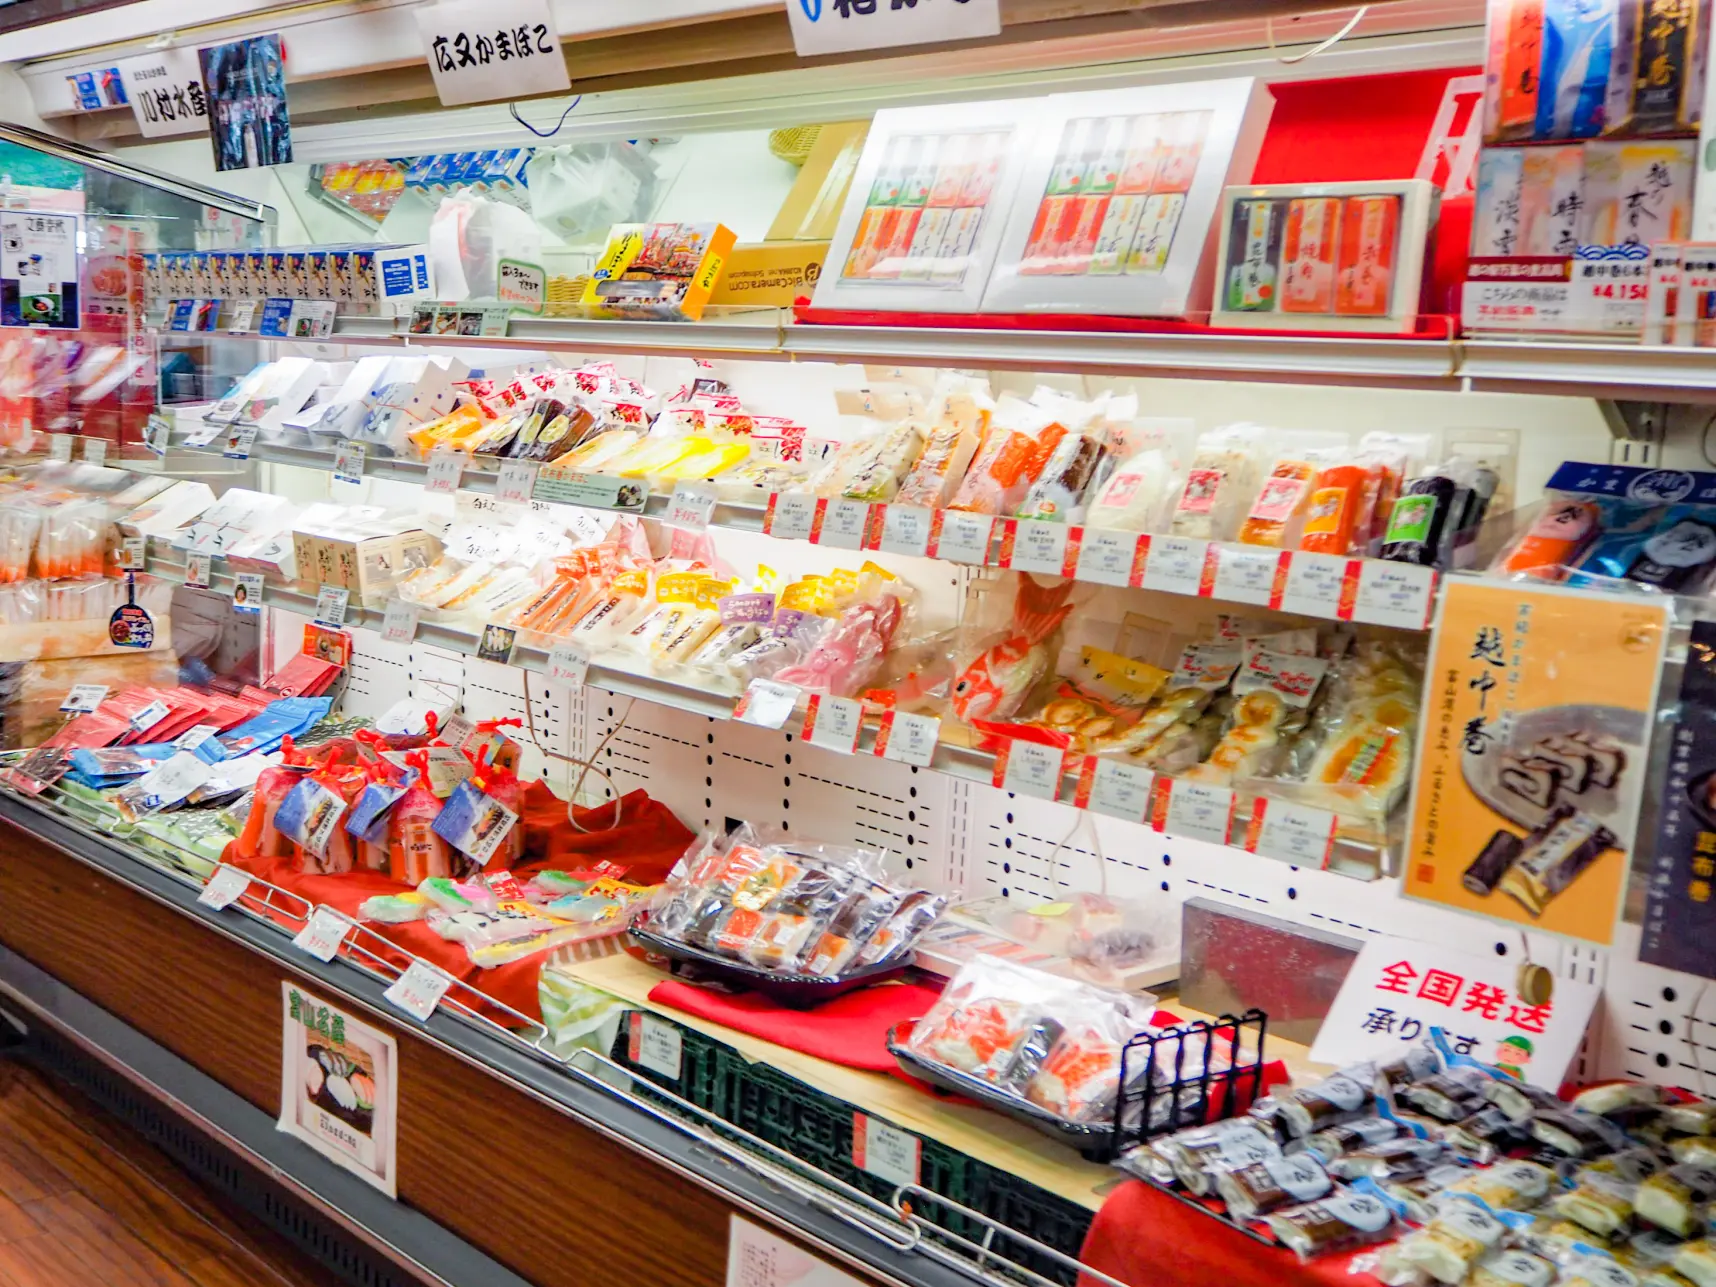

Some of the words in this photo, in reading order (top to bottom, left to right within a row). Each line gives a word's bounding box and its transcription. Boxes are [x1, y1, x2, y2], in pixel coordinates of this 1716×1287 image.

[432, 23, 554, 73] 広又かまぼこ
[1462, 625, 1507, 756] 越中巻
[1375, 960, 1553, 1034] 全国発送
[1361, 1007, 1482, 1056] 承りす
